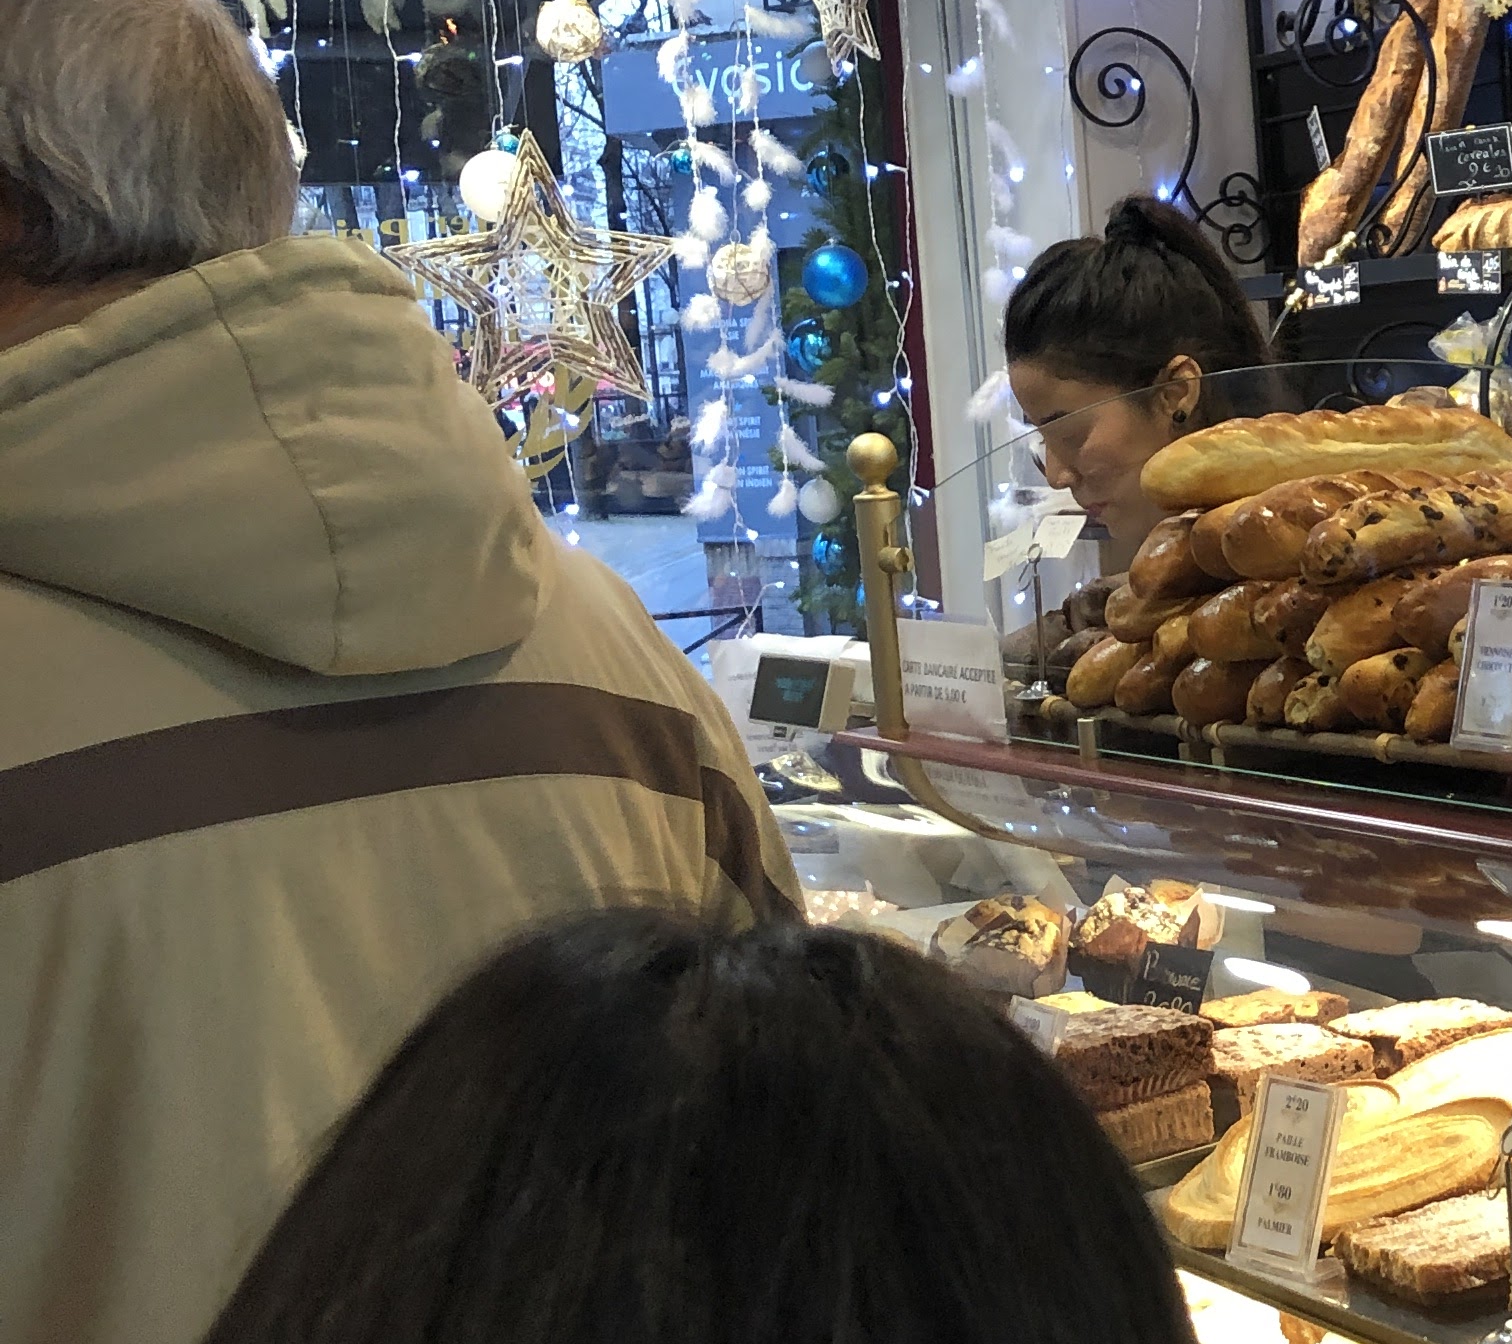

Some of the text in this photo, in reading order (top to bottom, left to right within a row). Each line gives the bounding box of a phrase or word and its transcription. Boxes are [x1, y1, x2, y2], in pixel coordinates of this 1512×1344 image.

[934, 686, 944, 701] DE
[1264, 1146, 1311, 1167] FRAMBOISE
[1257, 1216, 1293, 1236] PALMIER
